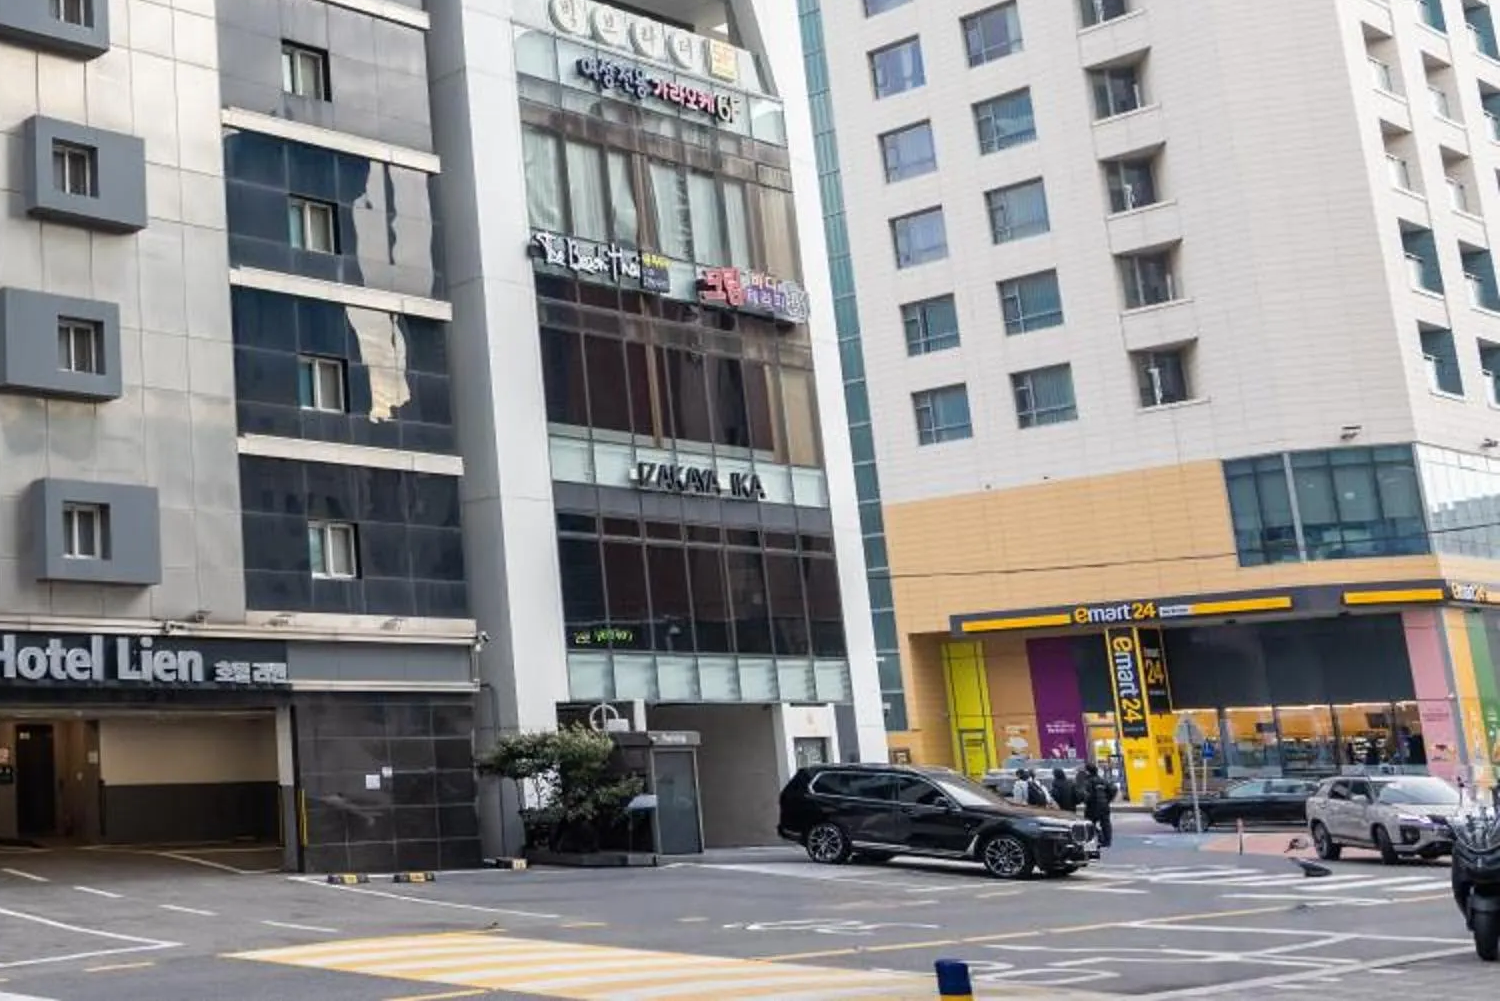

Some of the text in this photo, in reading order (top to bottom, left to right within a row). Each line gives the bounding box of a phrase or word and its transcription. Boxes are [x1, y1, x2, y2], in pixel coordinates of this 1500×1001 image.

[579, 57, 740, 123] 여성전용 가라오케 6F
[637, 462, 766, 499] IZAKAYA IKA
[116, 636, 204, 682] Lien
